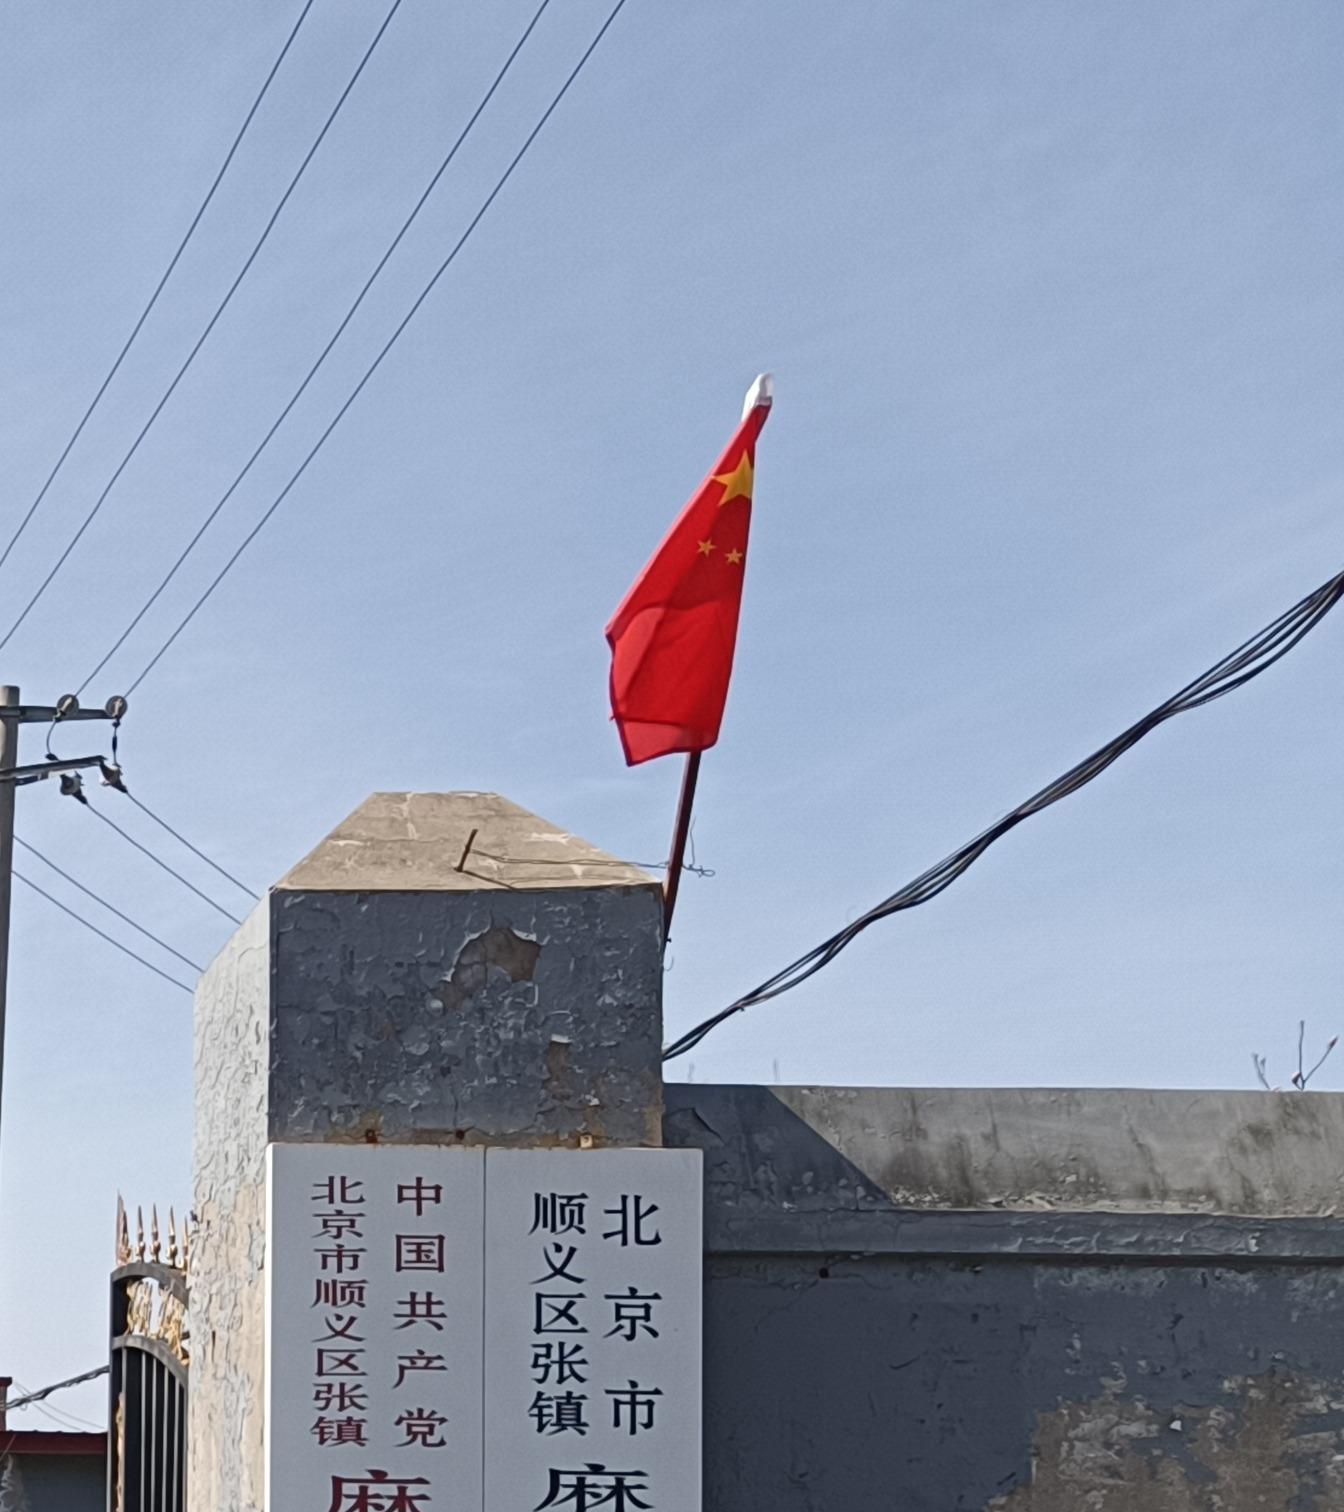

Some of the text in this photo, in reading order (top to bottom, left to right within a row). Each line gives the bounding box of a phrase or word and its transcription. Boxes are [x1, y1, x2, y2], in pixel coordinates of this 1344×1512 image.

[309, 1175, 370, 1448] 北京市顺义区张镇
[391, 1176, 449, 1448] 中国共产党
[527, 1192, 591, 1437] 顺义区张镇
[601, 1193, 665, 1437] 北京市
